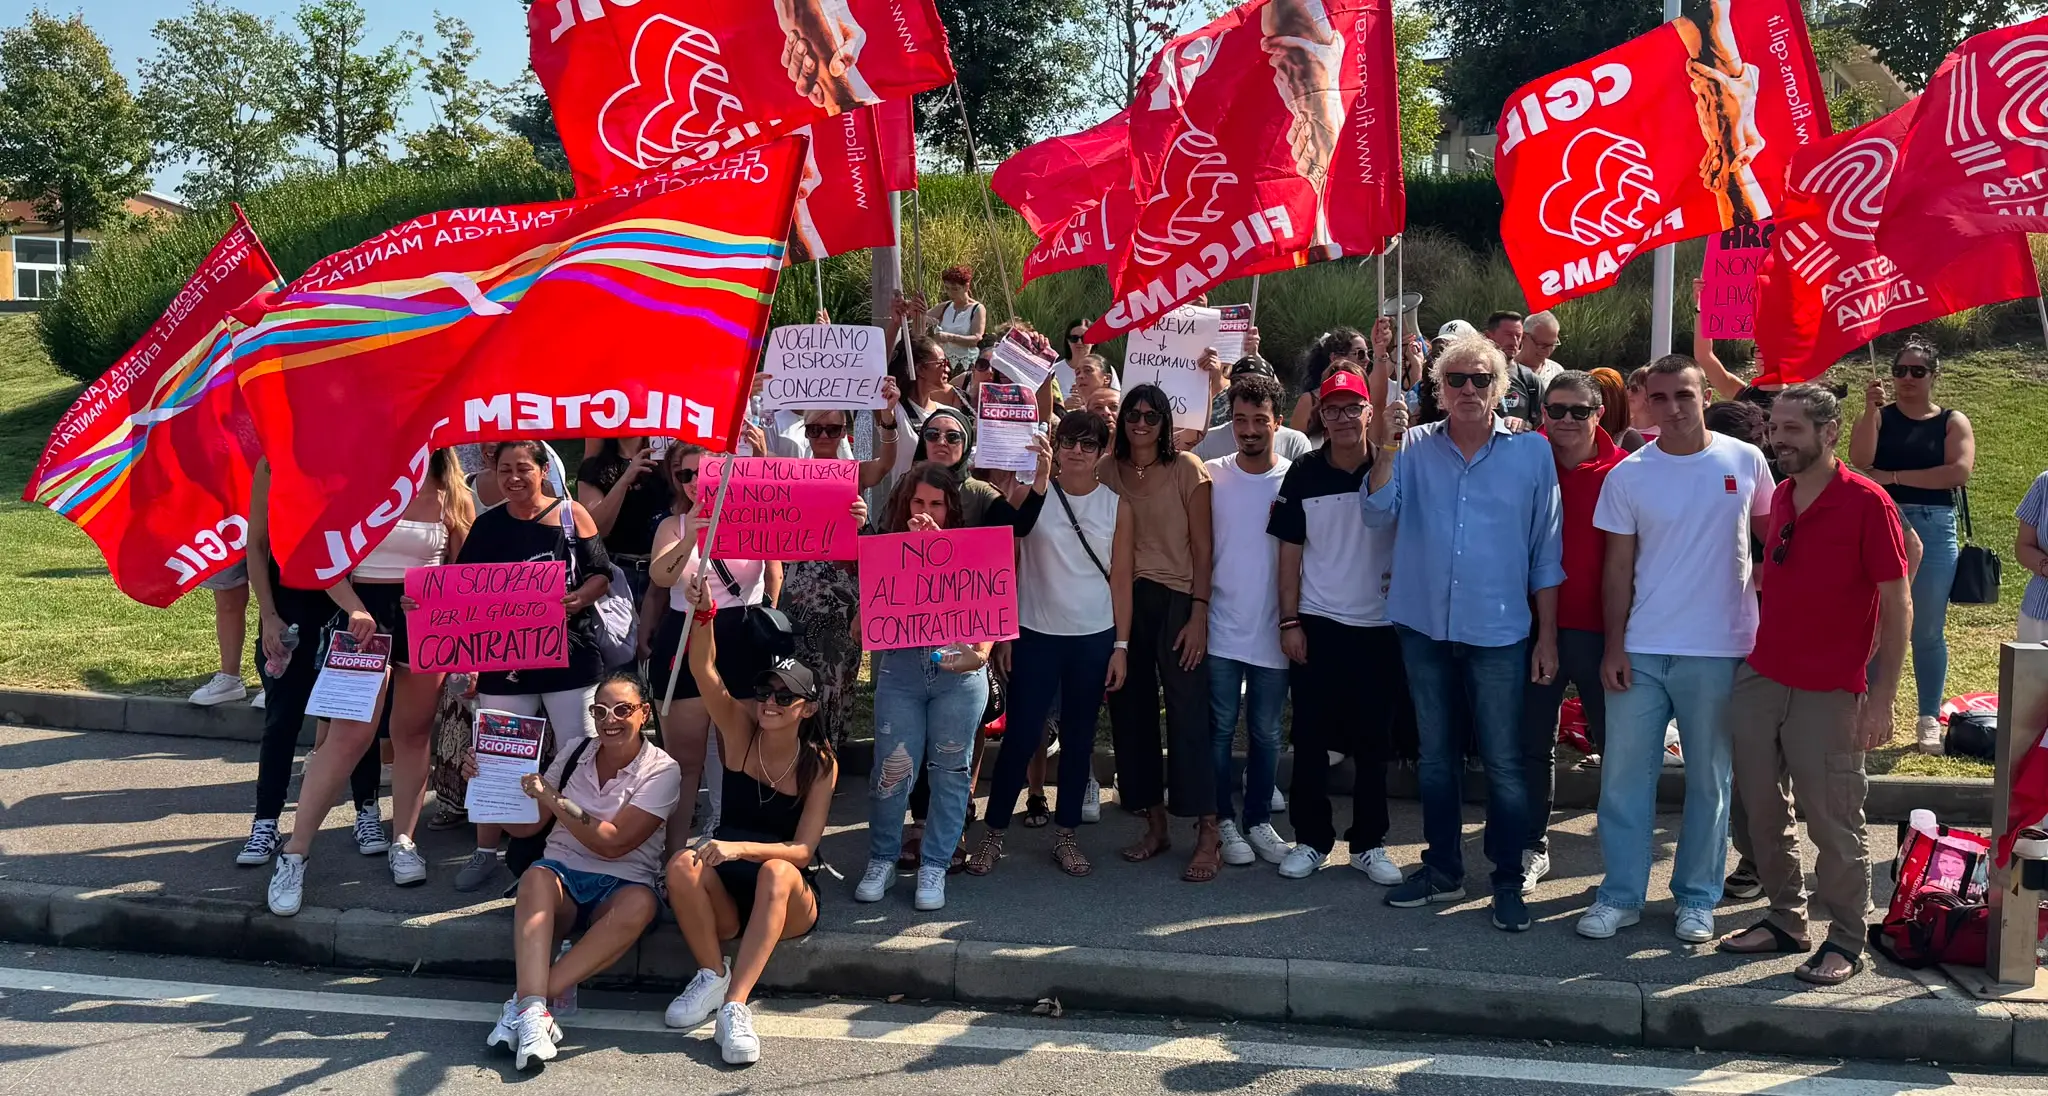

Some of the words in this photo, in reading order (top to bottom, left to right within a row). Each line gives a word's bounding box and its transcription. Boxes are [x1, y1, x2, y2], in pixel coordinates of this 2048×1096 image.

[1715, 255, 1759, 277] NON
[1709, 314, 1725, 333] DI
[774, 327, 869, 351] VOGLIAMO
[782, 352, 865, 371] RISPOSTE
[768, 376, 882, 400] CONCRETE!
[983, 408, 1035, 419] SCIOPERO
[743, 484, 792, 503] NON
[901, 537, 954, 570] NO
[422, 569, 447, 600] IN
[457, 563, 560, 595] SCIOPERO
[869, 575, 906, 609] AL
[915, 568, 1011, 606] DUMPING
[430, 607, 461, 627] PER
[465, 605, 481, 623] IL
[486, 601, 548, 622] GIUSTO
[867, 607, 1011, 646] CONTRATTUALE
[418, 618, 566, 670] CONTRATTO!
[329, 656, 382, 669] SCIOPERO
[478, 740, 534, 756] SCIOPERO
